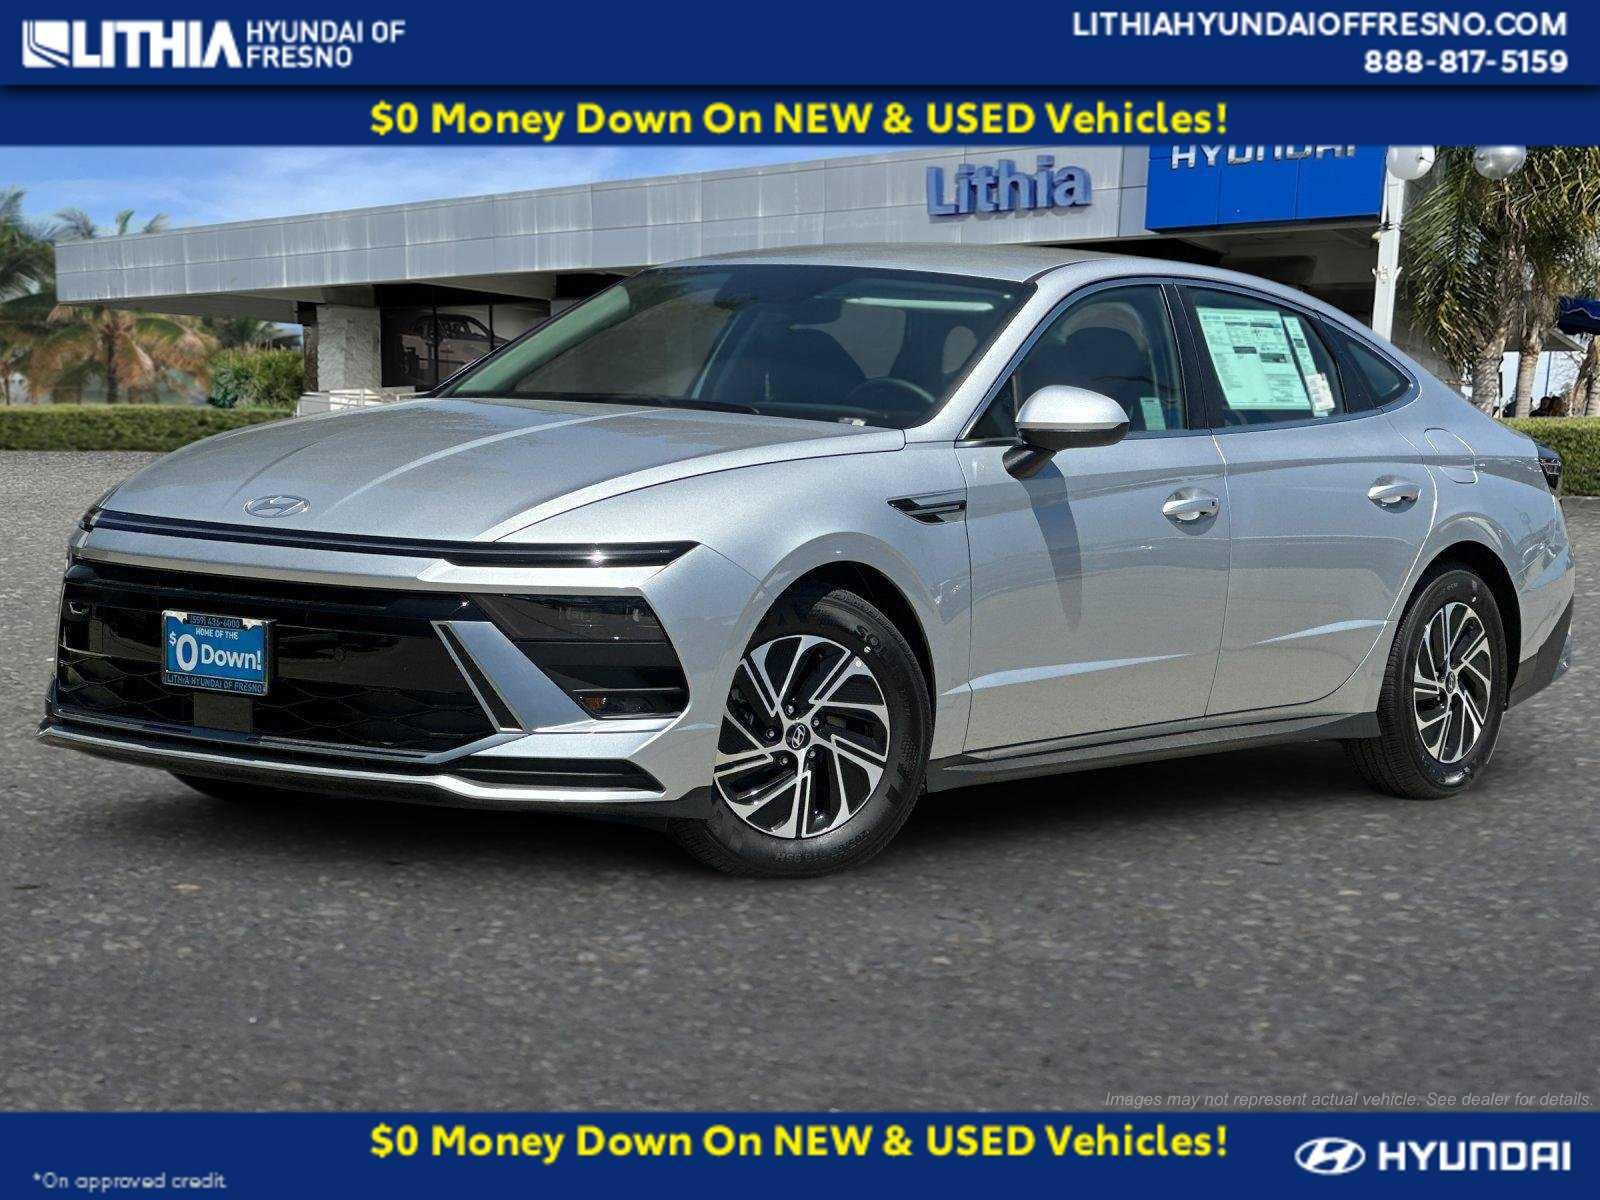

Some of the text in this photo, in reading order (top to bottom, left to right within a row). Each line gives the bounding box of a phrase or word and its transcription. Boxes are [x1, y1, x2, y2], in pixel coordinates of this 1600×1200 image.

[926, 155, 1093, 216] Lithia
[195, 627, 239, 640] HOME OF THE
[201, 643, 262, 671] Down!
[167, 674, 262, 693] LITHIA HYUNDAI OF FRESNO
